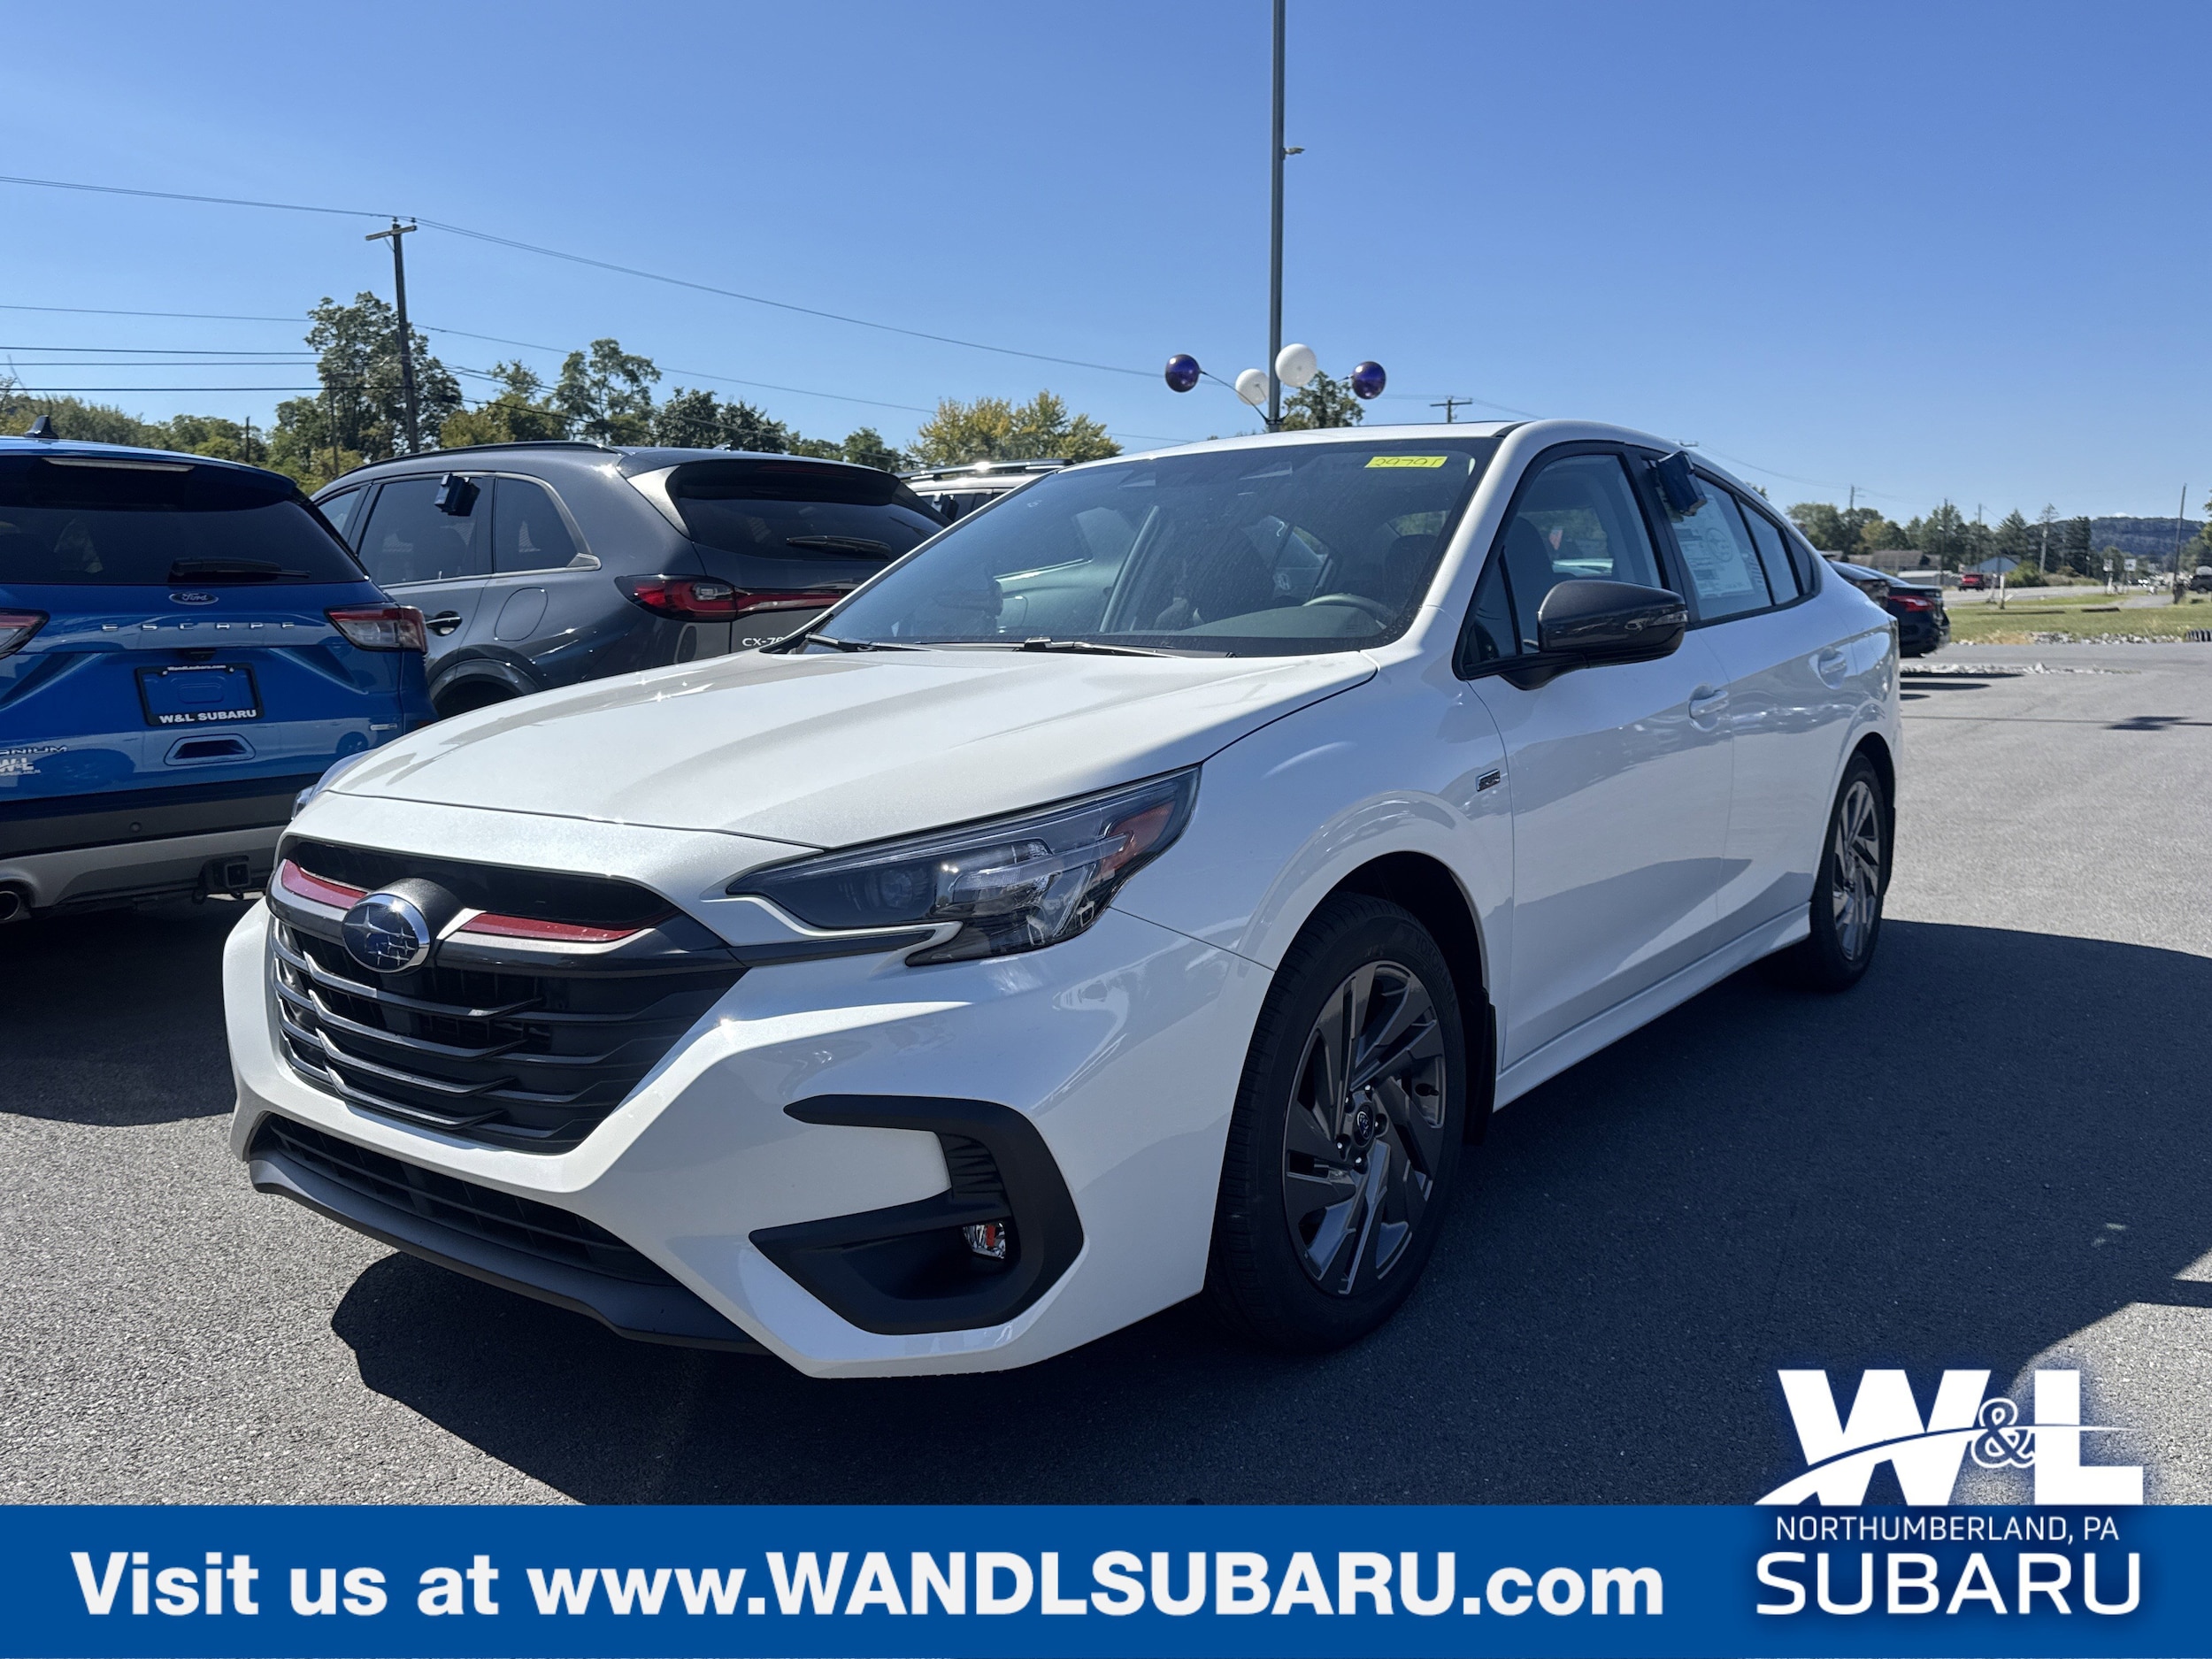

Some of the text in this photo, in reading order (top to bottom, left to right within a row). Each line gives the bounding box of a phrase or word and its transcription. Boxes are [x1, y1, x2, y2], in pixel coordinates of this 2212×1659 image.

[180, 592, 209, 603] Ford
[102, 622, 296, 632] ESCAPE
[159, 709, 257, 724] W&L SUBARU
